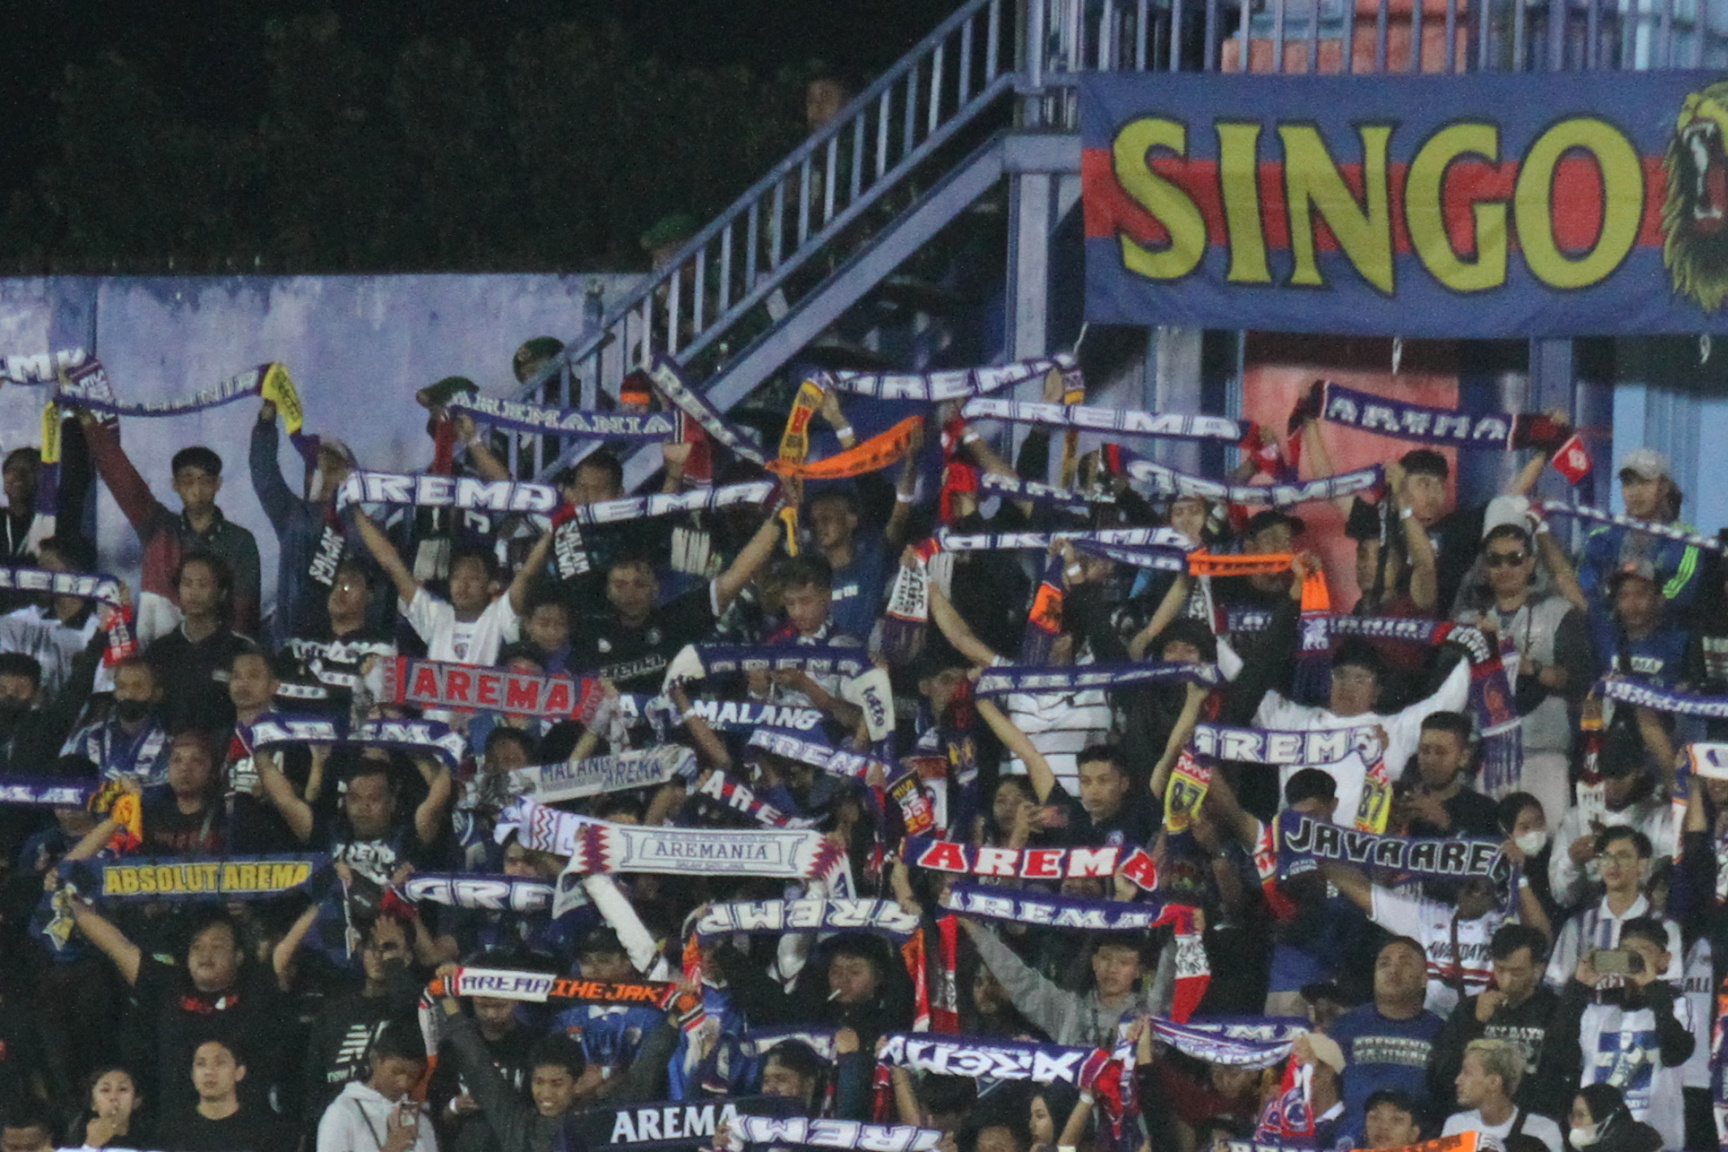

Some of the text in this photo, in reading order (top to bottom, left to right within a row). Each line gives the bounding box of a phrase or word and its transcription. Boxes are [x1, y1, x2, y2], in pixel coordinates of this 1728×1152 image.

[1111, 115, 1646, 296] SINGO
[450, 391, 673, 433] AREMANIA
[338, 472, 559, 511] AREMA
[413, 664, 573, 716] AREMA
[694, 699, 824, 730] MALANG
[751, 729, 882, 778] AREM
[1171, 781, 1202, 812] 87
[655, 843, 767, 862] AREMANIA
[918, 841, 1159, 890] AREMA
[1285, 815, 1507, 880] JAVA ARE
[104, 865, 219, 895] ABSOLUT
[221, 862, 310, 892] AREMA
[404, 875, 556, 912] ARE
[459, 975, 552, 996] AREMA
